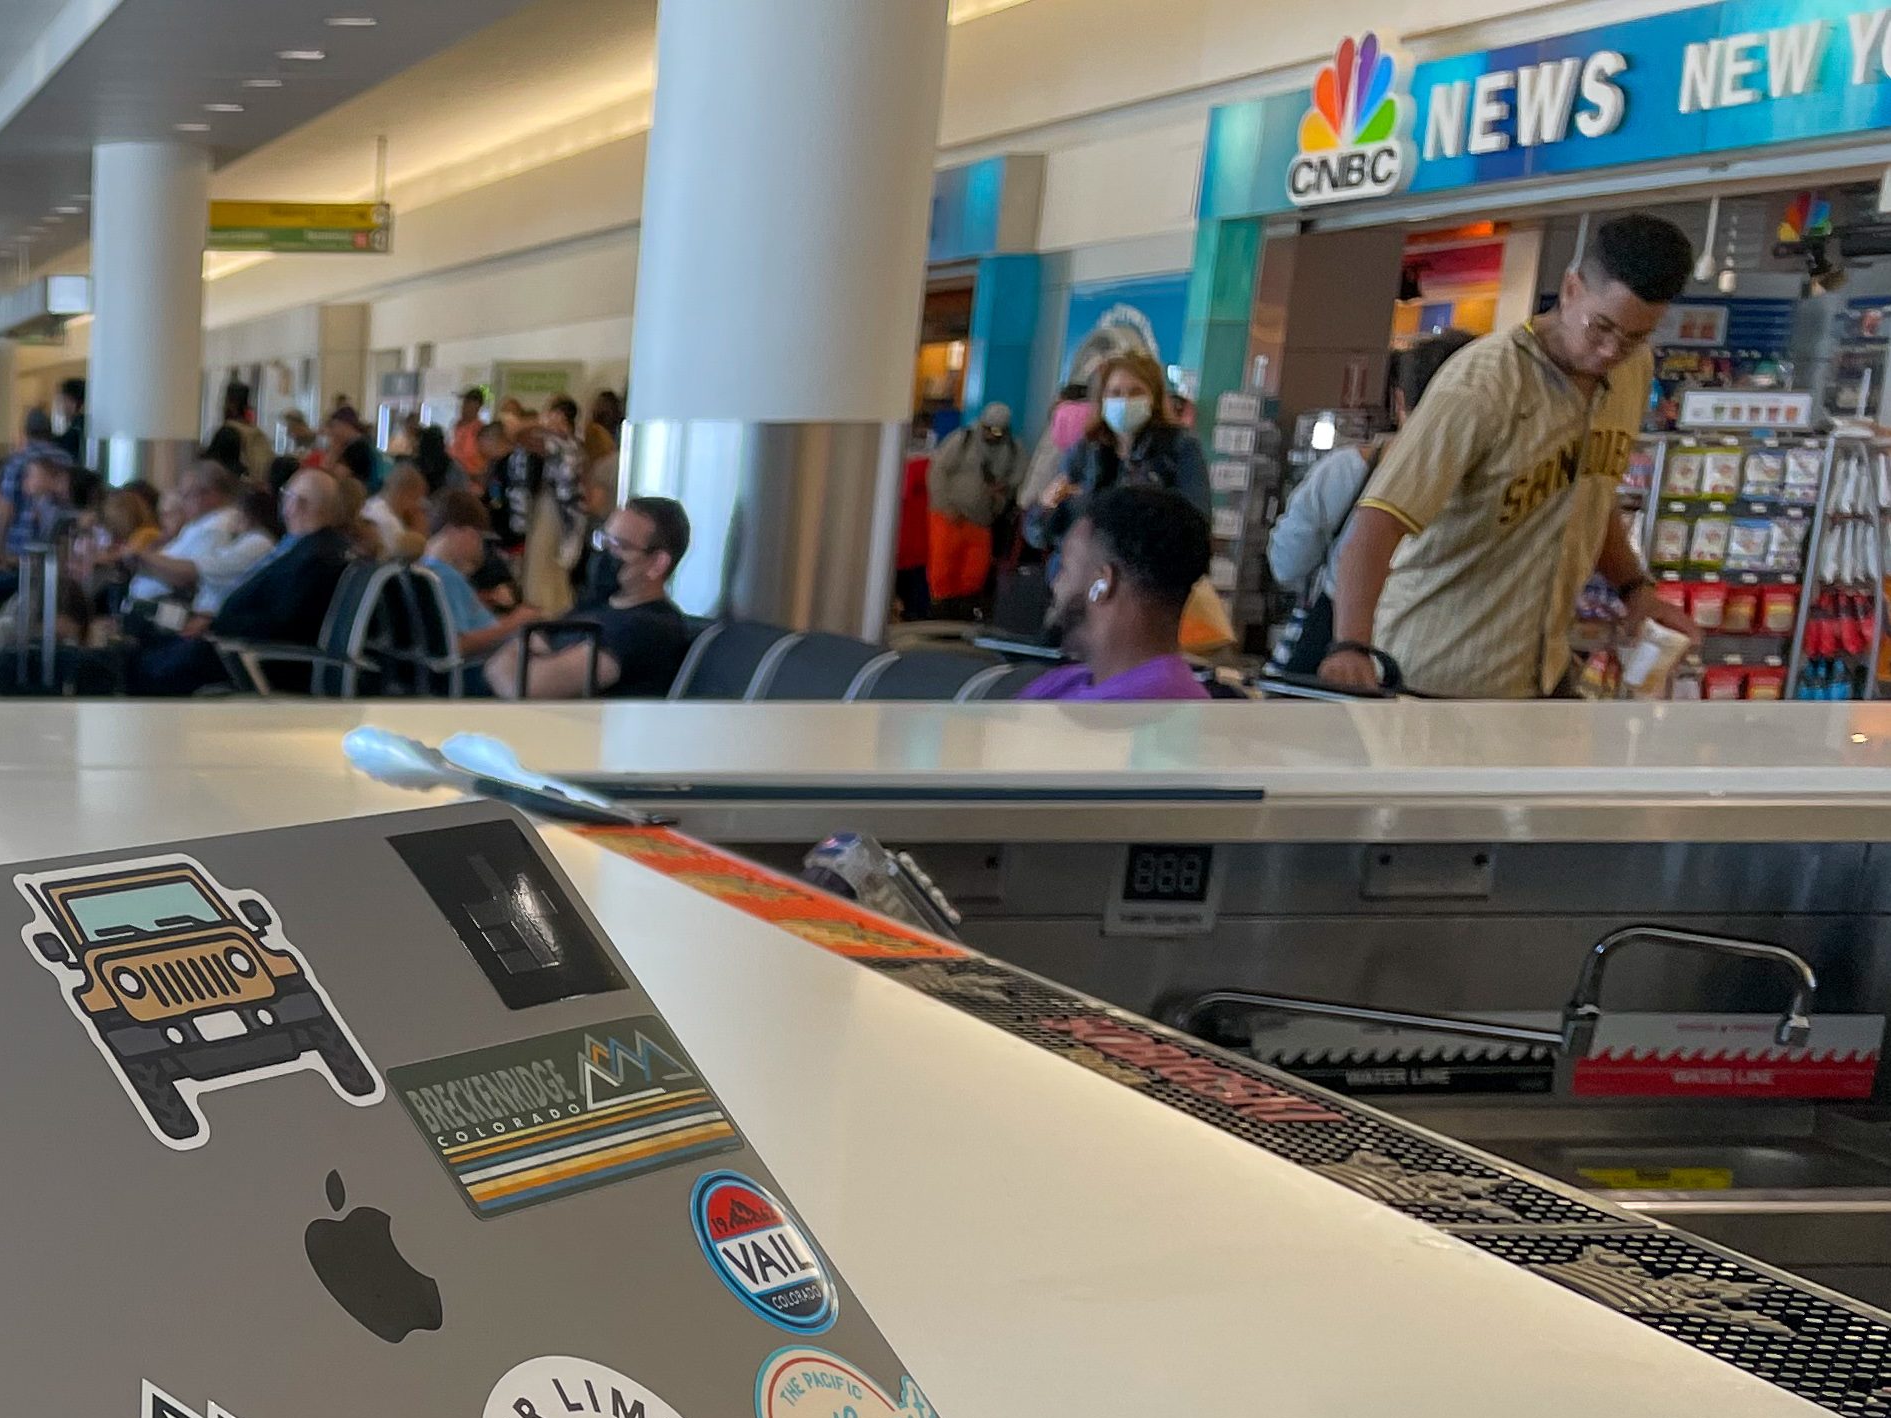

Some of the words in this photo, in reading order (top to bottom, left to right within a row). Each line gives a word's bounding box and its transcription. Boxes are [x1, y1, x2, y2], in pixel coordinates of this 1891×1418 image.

[1678, 18, 1829, 114] NEW
[1847, 8, 1891, 86] Y
[1423, 50, 1628, 162] NEWS
[1290, 148, 1398, 196] CNBC
[405, 1058, 577, 1135] BRECKENRIDGE
[436, 1103, 581, 1148] COLORADO
[721, 1233, 815, 1286] VAIL
[771, 1284, 822, 1311] COLORADO
[779, 1376, 806, 1407] THE
[802, 1371, 863, 1401] PACIFIC
